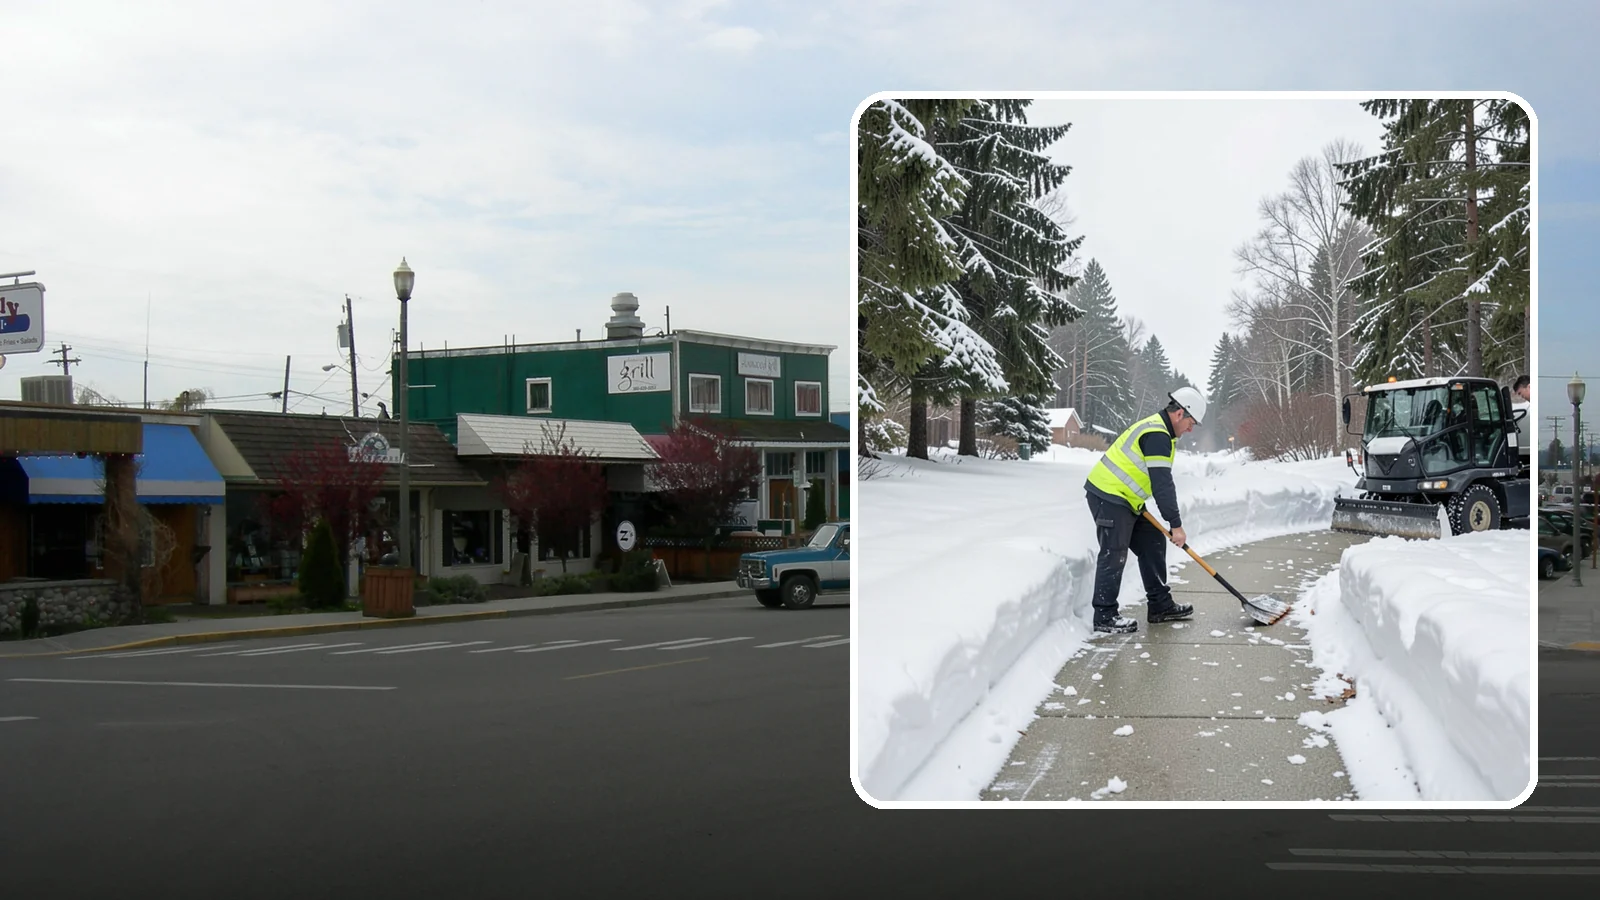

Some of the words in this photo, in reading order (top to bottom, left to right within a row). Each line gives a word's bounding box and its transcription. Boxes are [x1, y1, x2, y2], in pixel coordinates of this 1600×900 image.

[3, 338, 16, 346] Fries
[20, 337, 38, 345] Salads
[617, 356, 655, 392] grill
